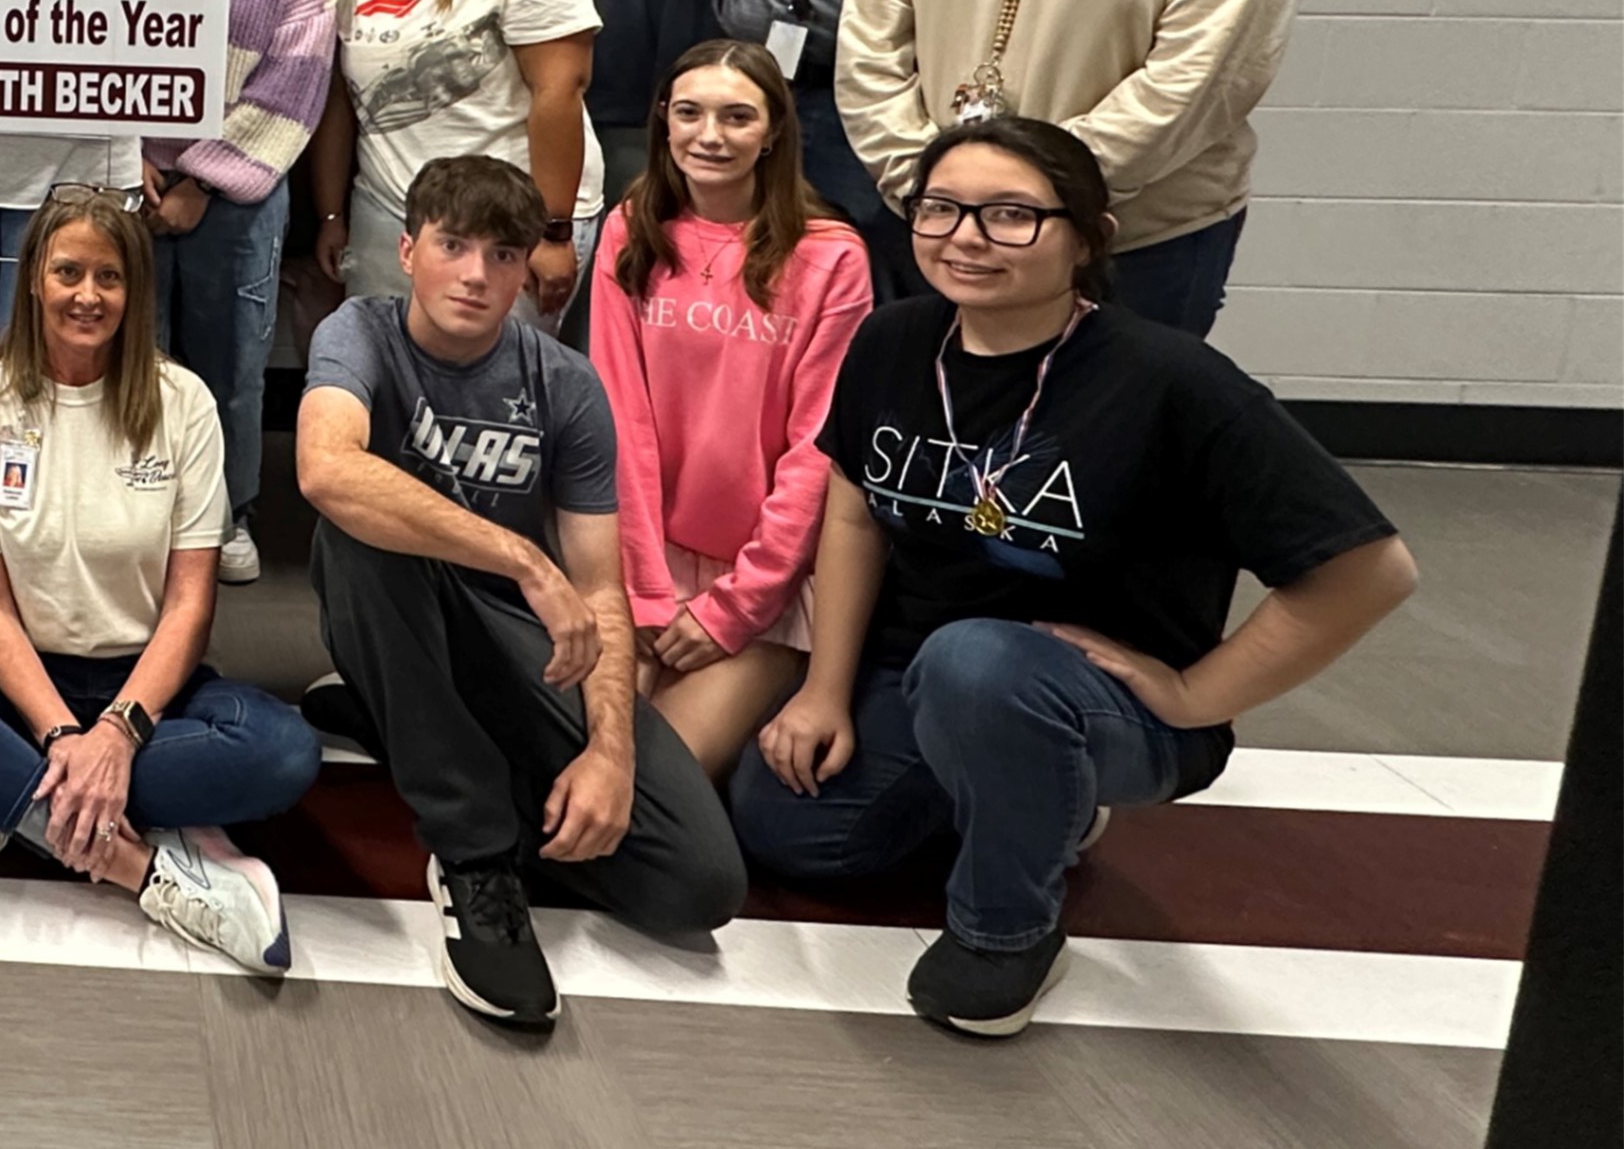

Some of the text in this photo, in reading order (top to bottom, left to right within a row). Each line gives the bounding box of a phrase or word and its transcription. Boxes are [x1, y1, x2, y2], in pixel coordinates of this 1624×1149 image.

[121, 0, 204, 48] Year
[55, 71, 195, 117] BECKER
[687, 300, 798, 346] COAST
[864, 425, 1083, 528] SITKA
